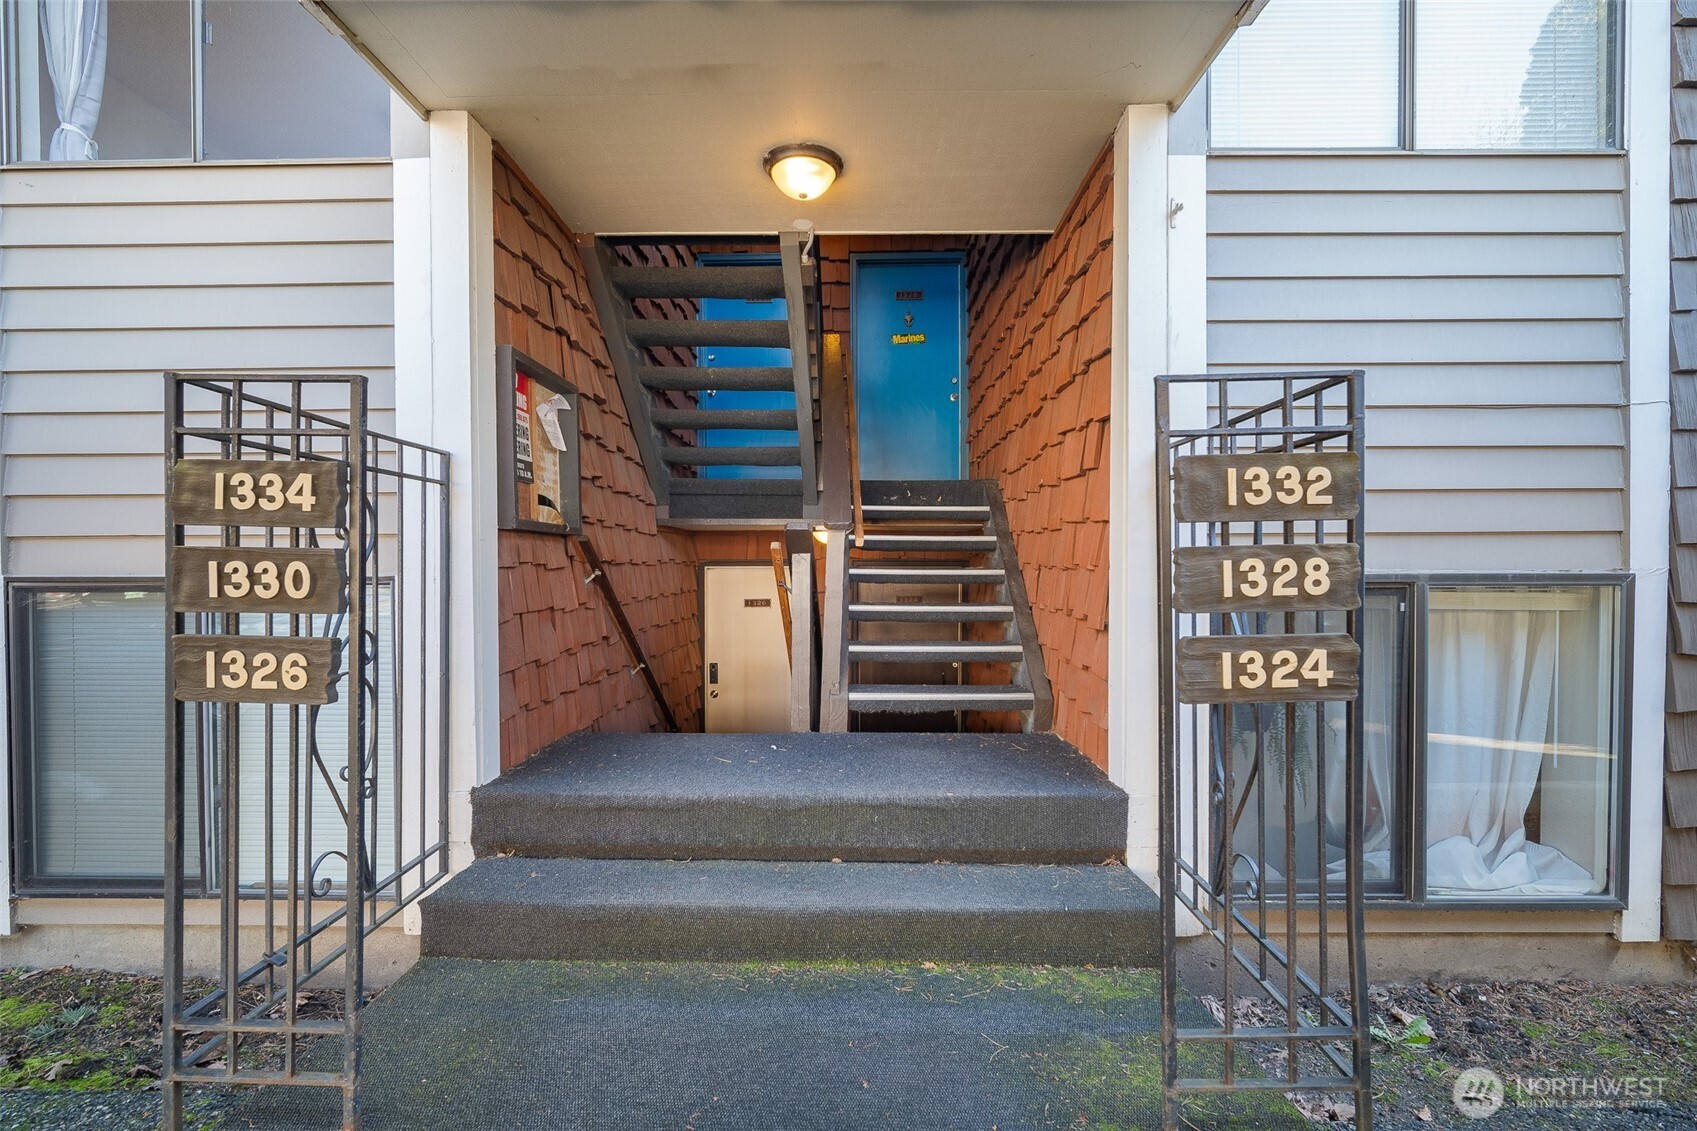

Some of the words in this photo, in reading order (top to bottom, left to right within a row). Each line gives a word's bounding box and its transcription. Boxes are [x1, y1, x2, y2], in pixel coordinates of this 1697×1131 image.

[892, 333, 925, 344] Marines
[214, 472, 316, 511] 1334
[1227, 465, 1333, 506] 1332
[208, 560, 310, 599] 1330
[1222, 557, 1330, 598] 1328
[206, 650, 308, 690] 1326
[1221, 648, 1334, 690] 1324
